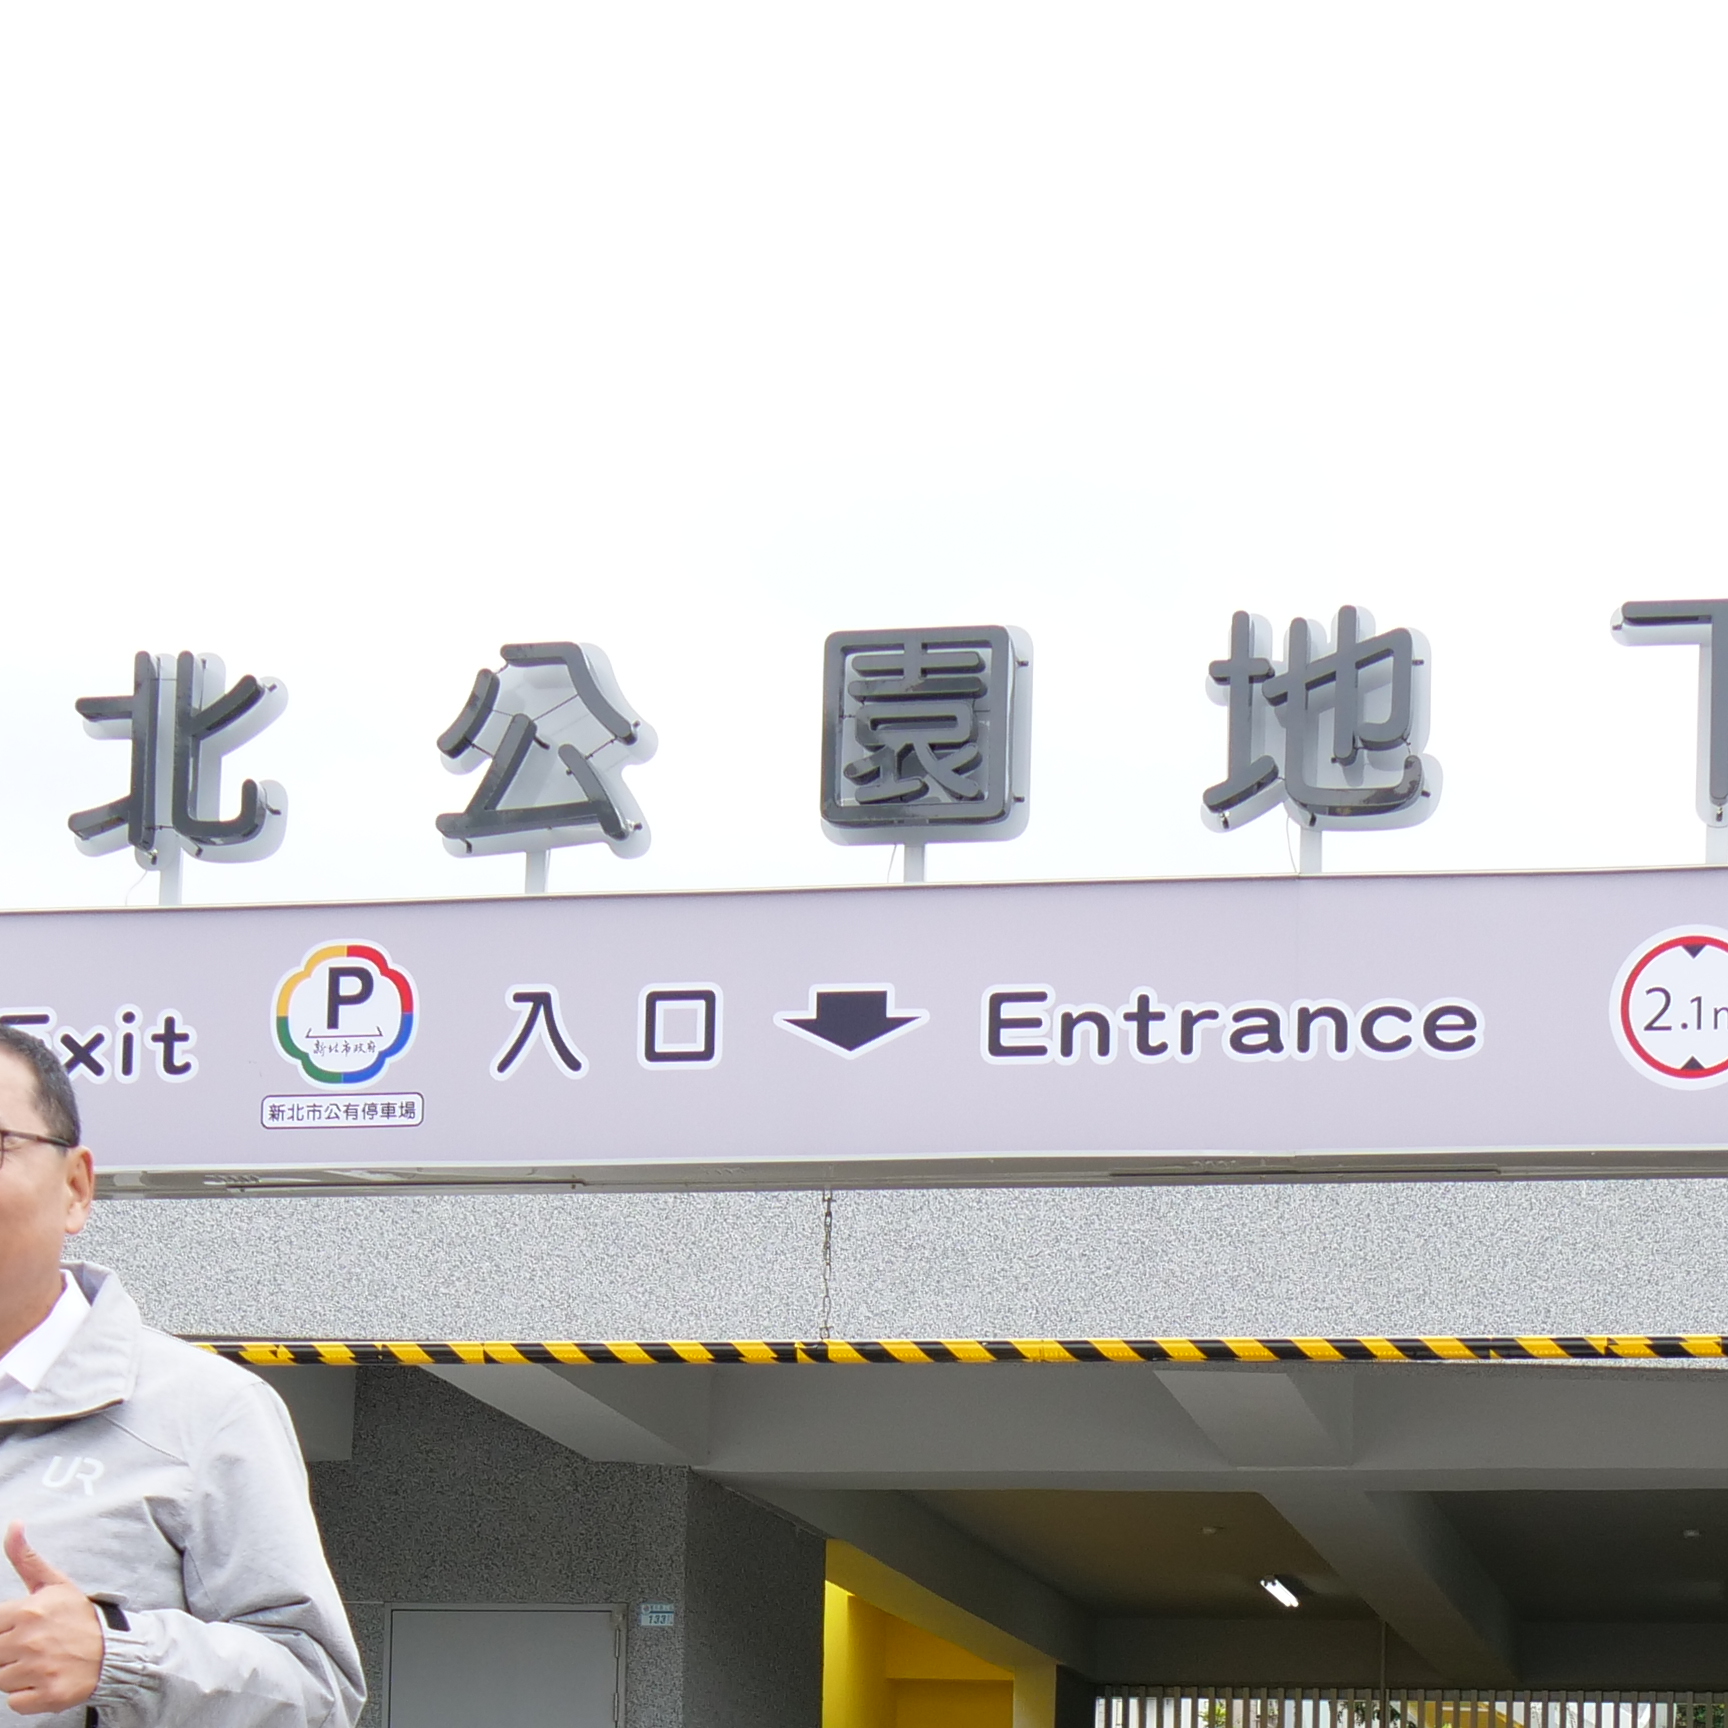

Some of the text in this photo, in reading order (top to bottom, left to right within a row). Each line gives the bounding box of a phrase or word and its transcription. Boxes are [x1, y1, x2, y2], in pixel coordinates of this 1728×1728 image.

[326, 966, 375, 1030] P
[986, 990, 1478, 1059] Entrance
[312, 1039, 378, 1058] 新北市政府
[494, 987, 719, 1077] 入口
[268, 1101, 417, 1122] 新北市公有停車場
[42, 1455, 105, 1497] UR
